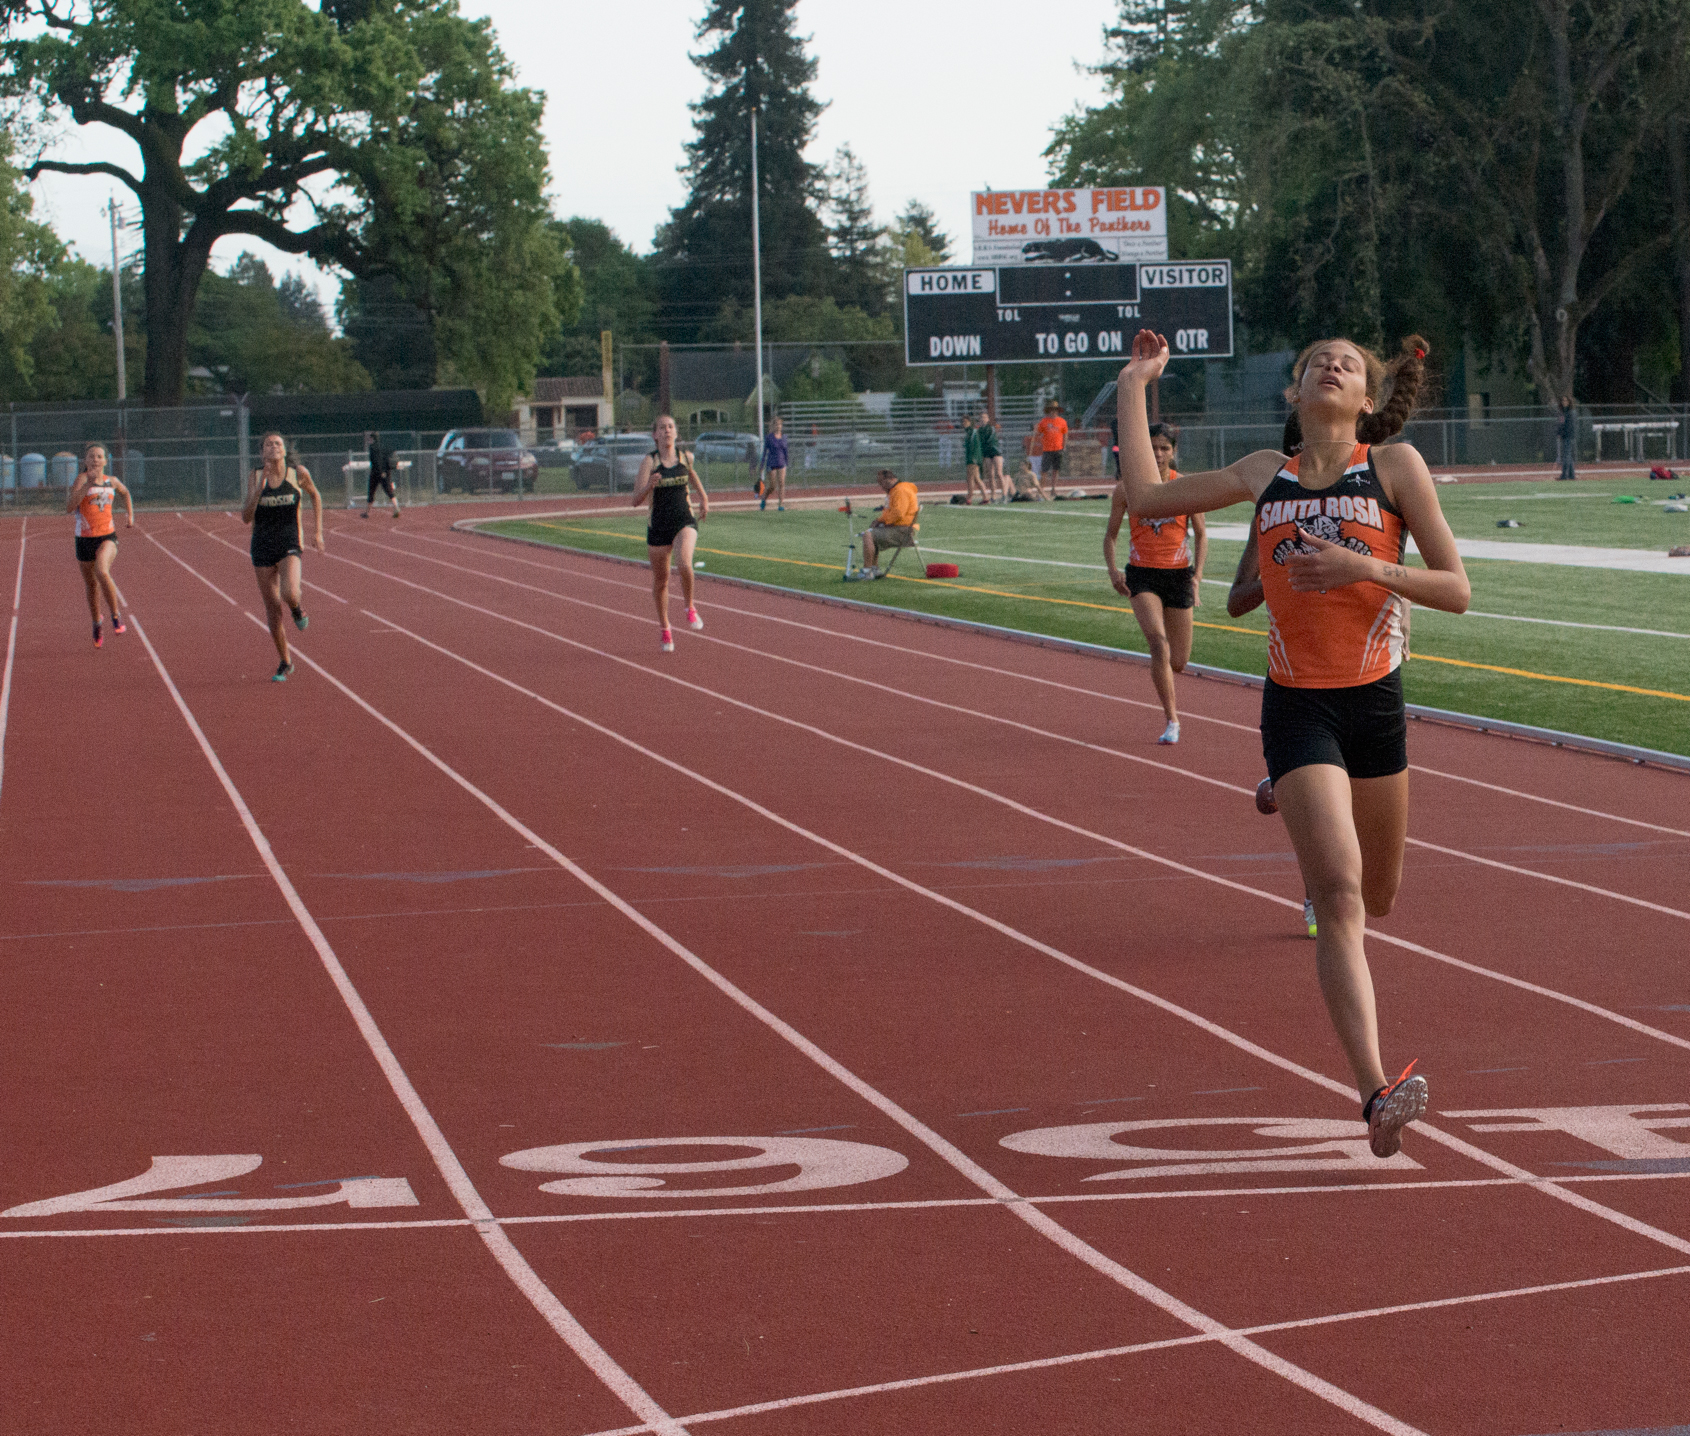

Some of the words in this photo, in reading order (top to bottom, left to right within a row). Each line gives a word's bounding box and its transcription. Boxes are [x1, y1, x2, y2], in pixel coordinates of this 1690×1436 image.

[976, 191, 1077, 216] NEVERS
[1091, 188, 1161, 215] FIELD
[988, 219, 1027, 236] Home
[1034, 217, 1051, 236] Of
[1057, 217, 1082, 234] The
[1089, 216, 1151, 233] Panthers
[920, 274, 982, 291] HOME
[1145, 268, 1223, 285] VISITOR
[997, 309, 1021, 321] TOL
[1117, 305, 1141, 318] TOL
[929, 335, 982, 357] DOWN
[1035, 333, 1059, 354] TO
[1064, 332, 1089, 353] GO
[1097, 331, 1122, 352] ON
[1175, 329, 1209, 352] QTR
[1260, 498, 1321, 533] SANTA
[1325, 495, 1384, 531] ROSA
[0, 1154, 419, 1218] 7
